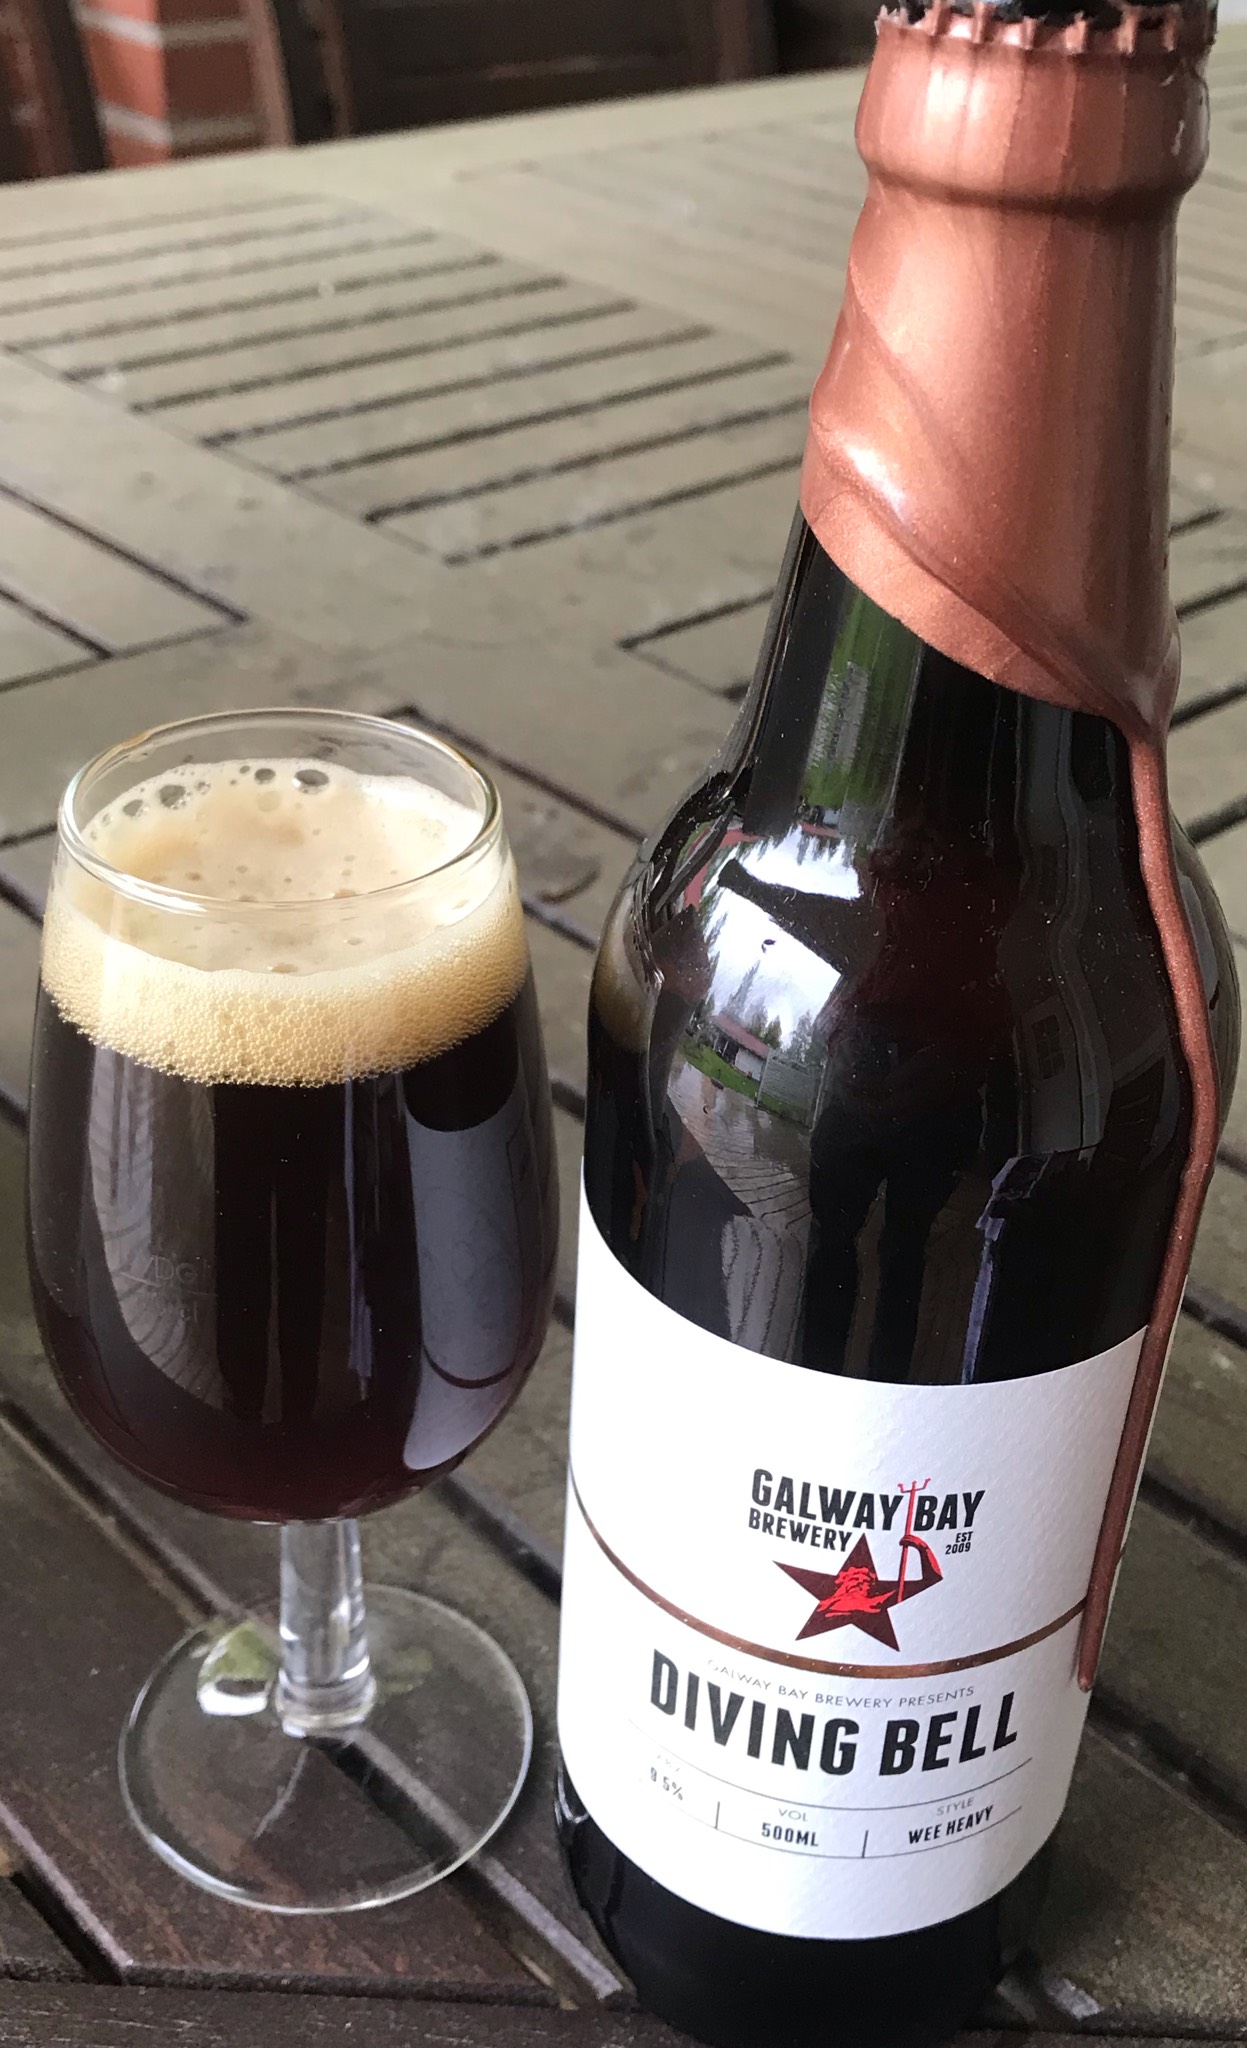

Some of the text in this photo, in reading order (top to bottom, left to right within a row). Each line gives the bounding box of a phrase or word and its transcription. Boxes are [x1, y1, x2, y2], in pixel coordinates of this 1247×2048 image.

[751, 1468, 986, 1532] GALWAY BAY
[748, 1507, 853, 1552] BREWERY
[955, 1531, 974, 1543] EST
[945, 1541, 972, 1555] 2009
[778, 1684, 808, 1700] BAY
[815, 1692, 893, 1709] BREWERY
[898, 1685, 975, 1708] PRESENTS
[650, 1648, 1018, 1776] DIVING BELL
[650, 1766, 683, 1800] 95%
[778, 1808, 808, 1822] VOL
[936, 1796, 975, 1816] STYLE
[761, 1822, 819, 1847] 500ML
[908, 1805, 993, 1844] WEE HEAVY
